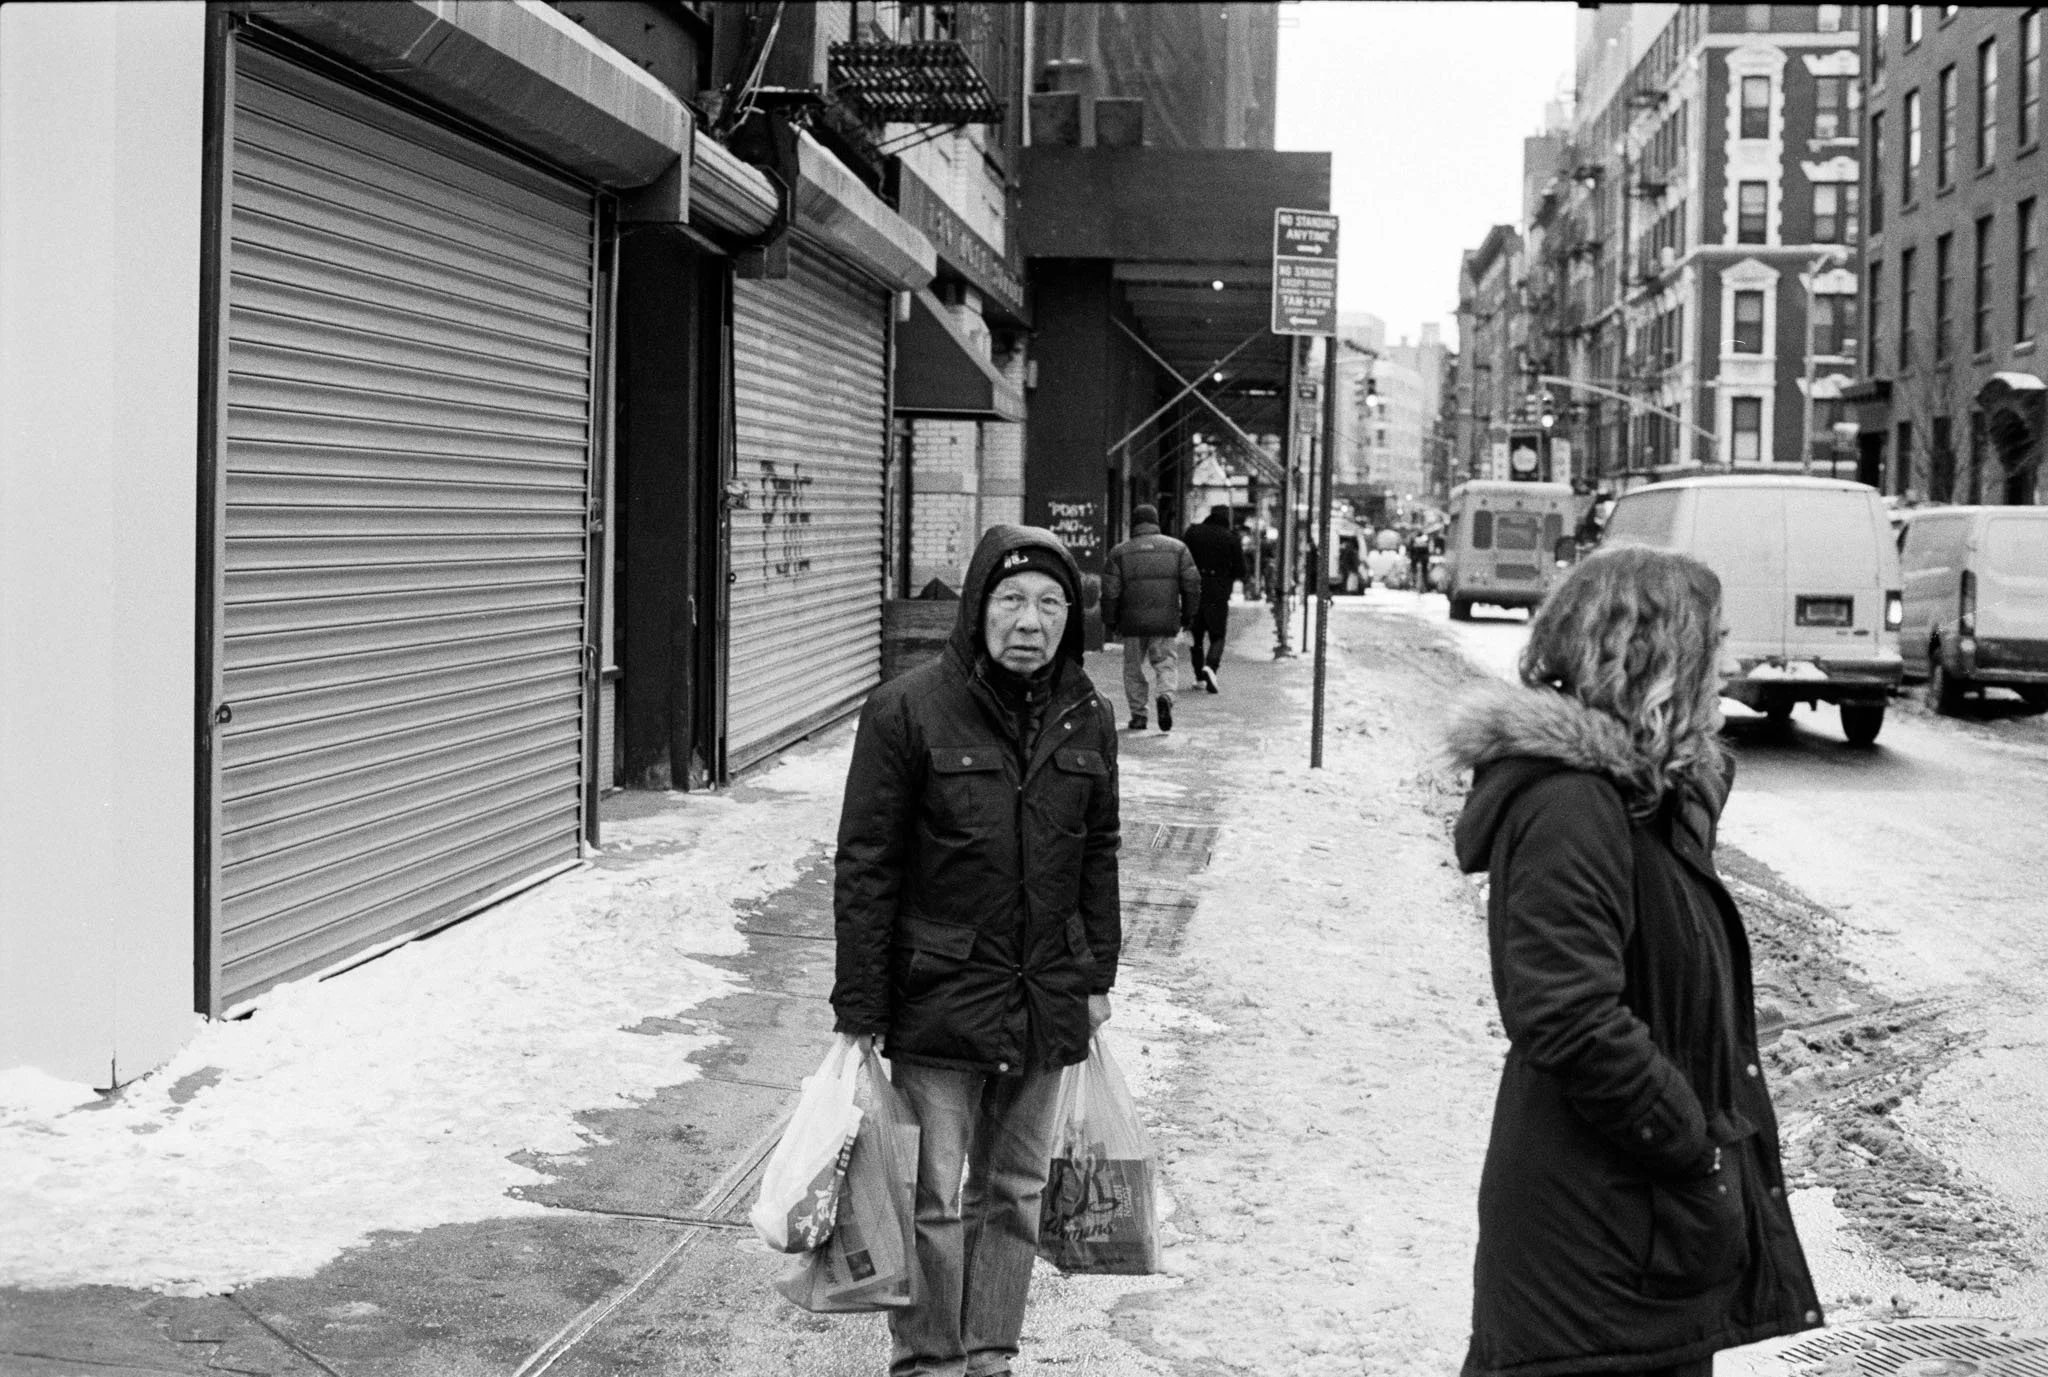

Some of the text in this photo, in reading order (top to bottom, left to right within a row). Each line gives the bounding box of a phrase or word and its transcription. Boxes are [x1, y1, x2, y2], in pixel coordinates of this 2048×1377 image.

[1280, 213, 1337, 230] NO STANDING
[1286, 229, 1330, 243] ANYTIME
[1279, 264, 1292, 277] NO
